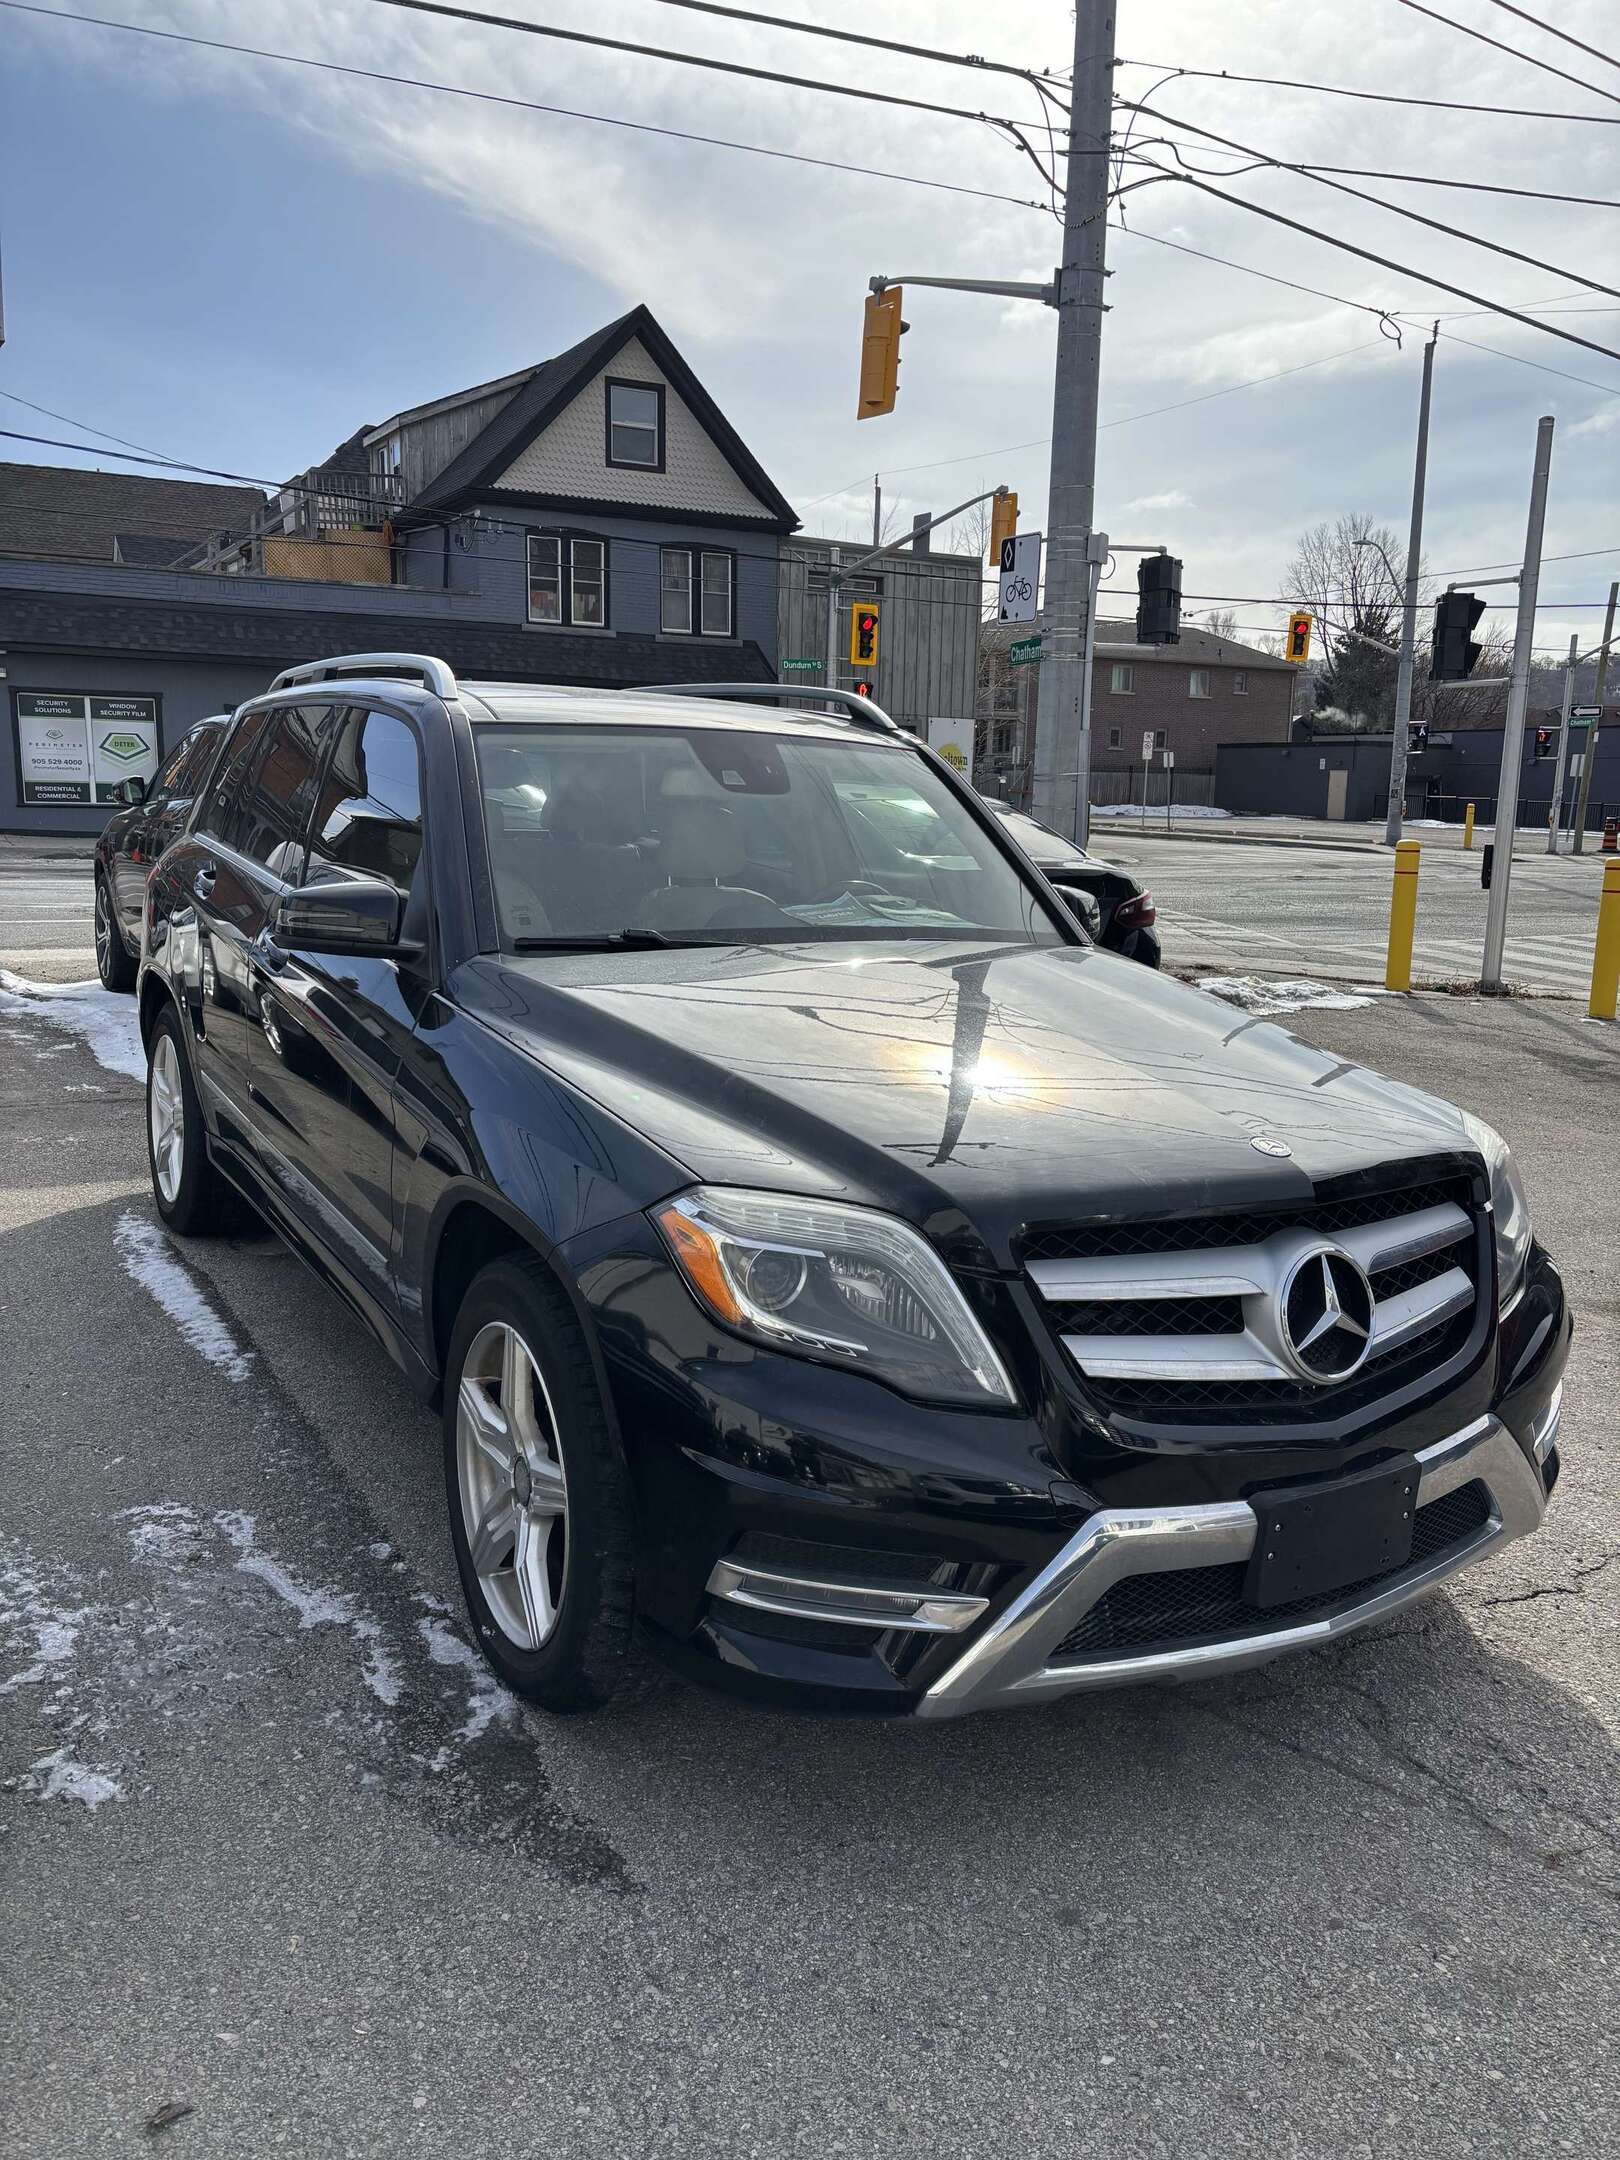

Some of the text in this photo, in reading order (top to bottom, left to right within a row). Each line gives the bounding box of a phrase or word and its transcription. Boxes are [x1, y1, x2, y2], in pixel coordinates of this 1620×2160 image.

[1011, 645, 1041, 661] Chatham
[783, 660, 812, 669] Dundurn
[817, 661, 822, 669] S
[48, 758, 62, 766] 529
